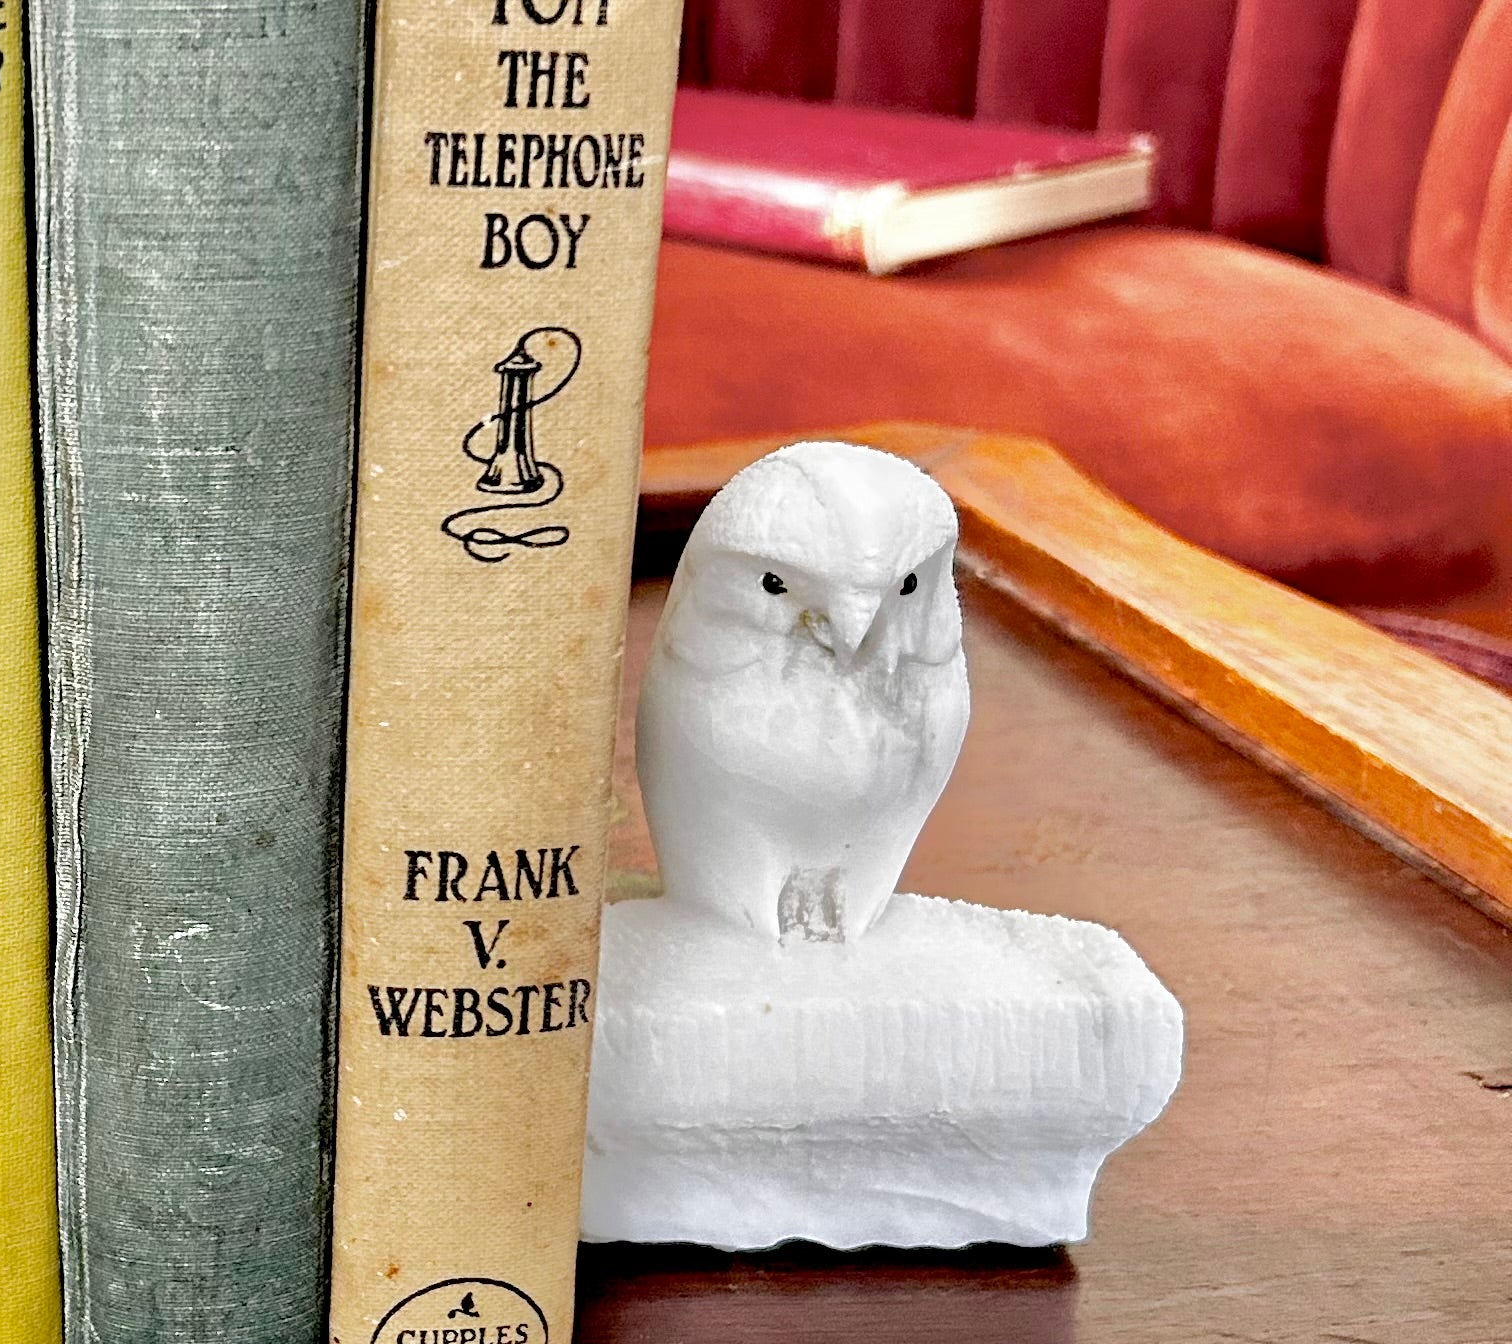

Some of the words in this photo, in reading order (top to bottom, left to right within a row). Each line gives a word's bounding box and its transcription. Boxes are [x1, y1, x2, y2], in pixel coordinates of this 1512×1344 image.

[497, 50, 591, 109] THE
[424, 131, 645, 189] TELEPHONE
[479, 213, 592, 271] BOY
[402, 845, 581, 903] FRANK
[462, 919, 510, 970] V.
[366, 978, 591, 1039] WEBSTER
